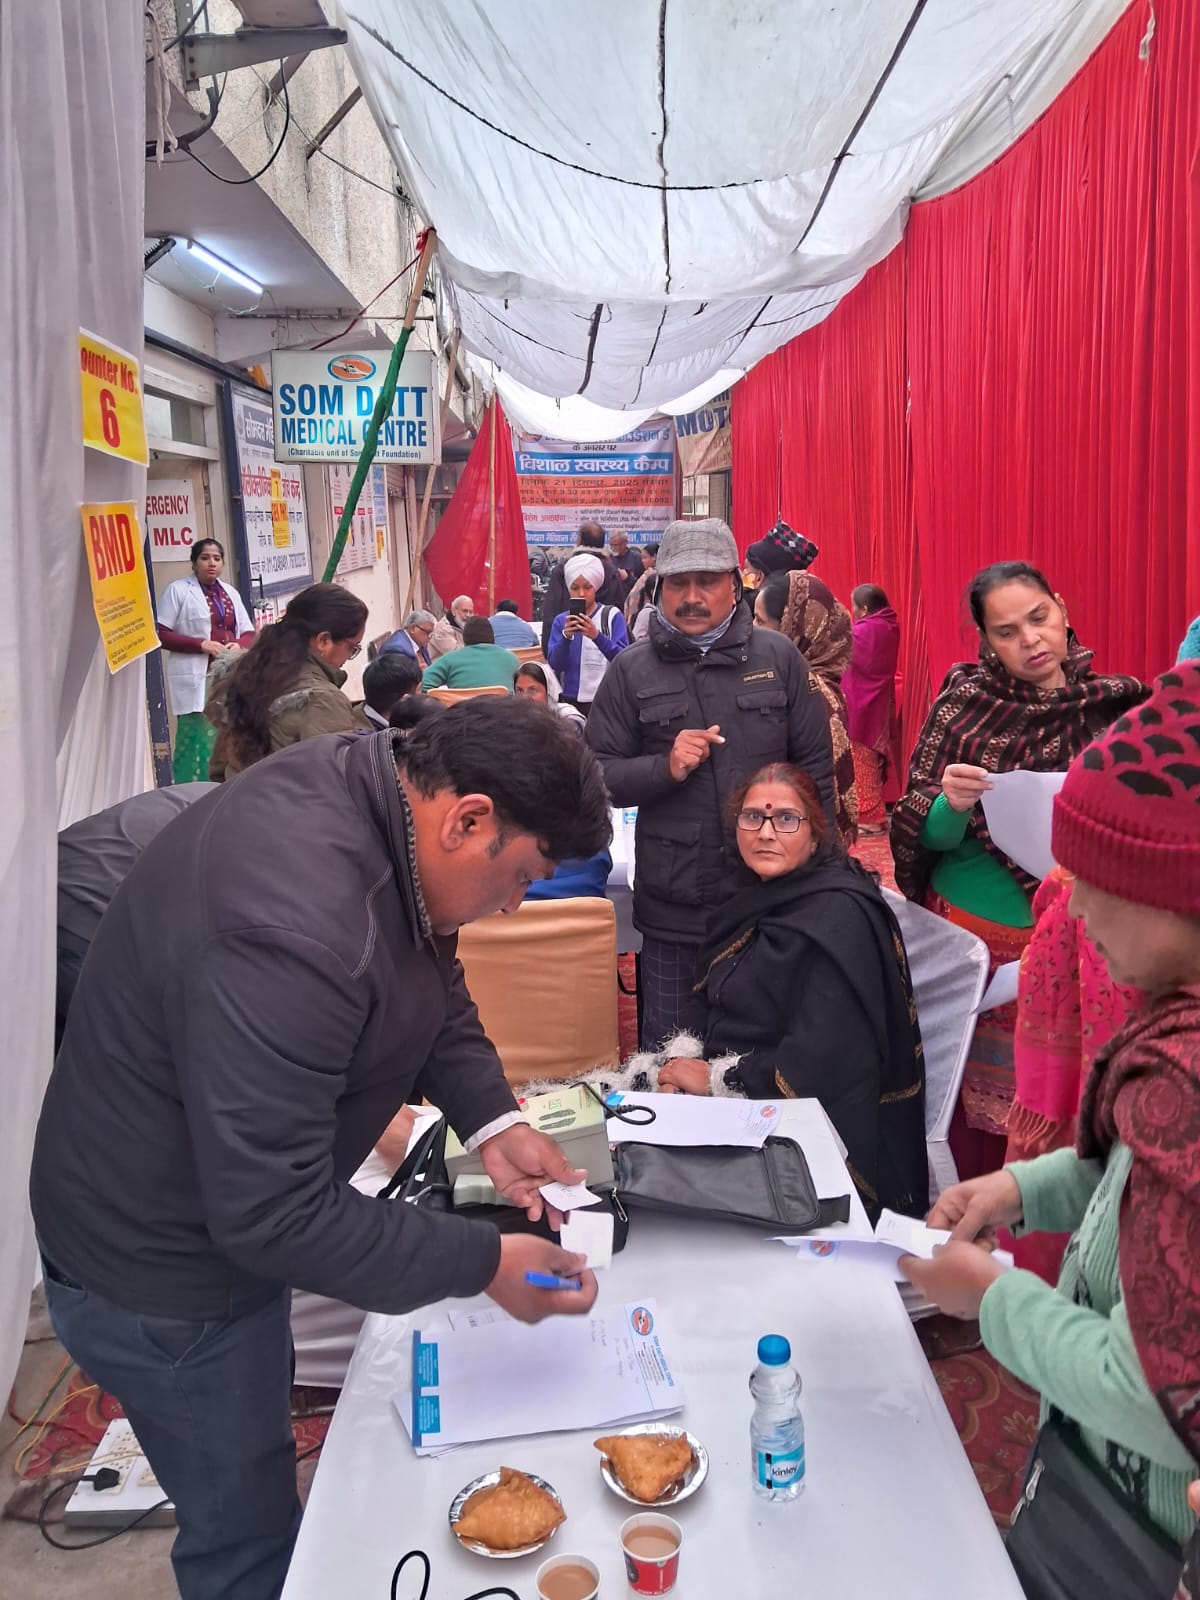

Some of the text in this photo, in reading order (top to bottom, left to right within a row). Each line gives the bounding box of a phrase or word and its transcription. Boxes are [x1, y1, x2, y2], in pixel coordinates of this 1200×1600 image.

[120, 361, 138, 395] No.
[279, 384, 428, 417] SOM DTT
[100, 388, 120, 448] 6
[281, 418, 356, 446] MEDICAL
[341, 449, 348, 457] of
[382, 450, 421, 460] Foundation)
[519, 454, 570, 472] विशाल
[89, 513, 136, 581] BMD
[153, 527, 193, 546] MLC
